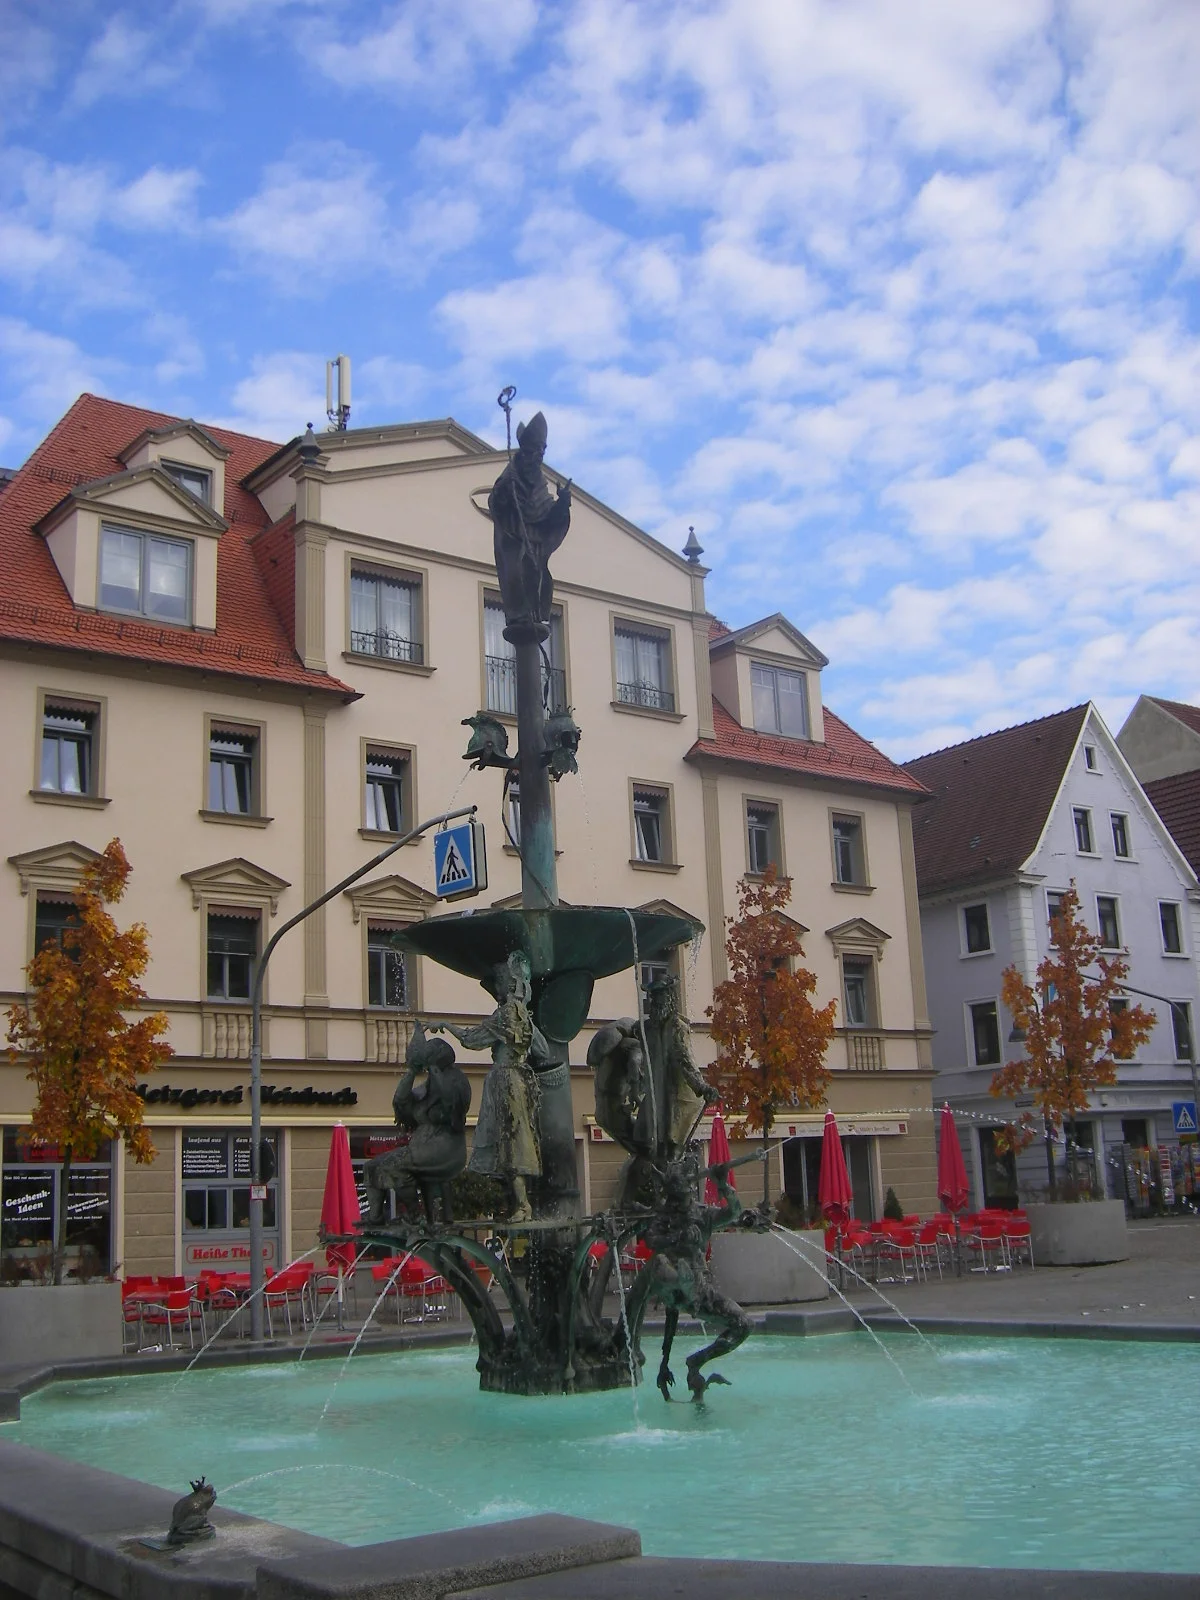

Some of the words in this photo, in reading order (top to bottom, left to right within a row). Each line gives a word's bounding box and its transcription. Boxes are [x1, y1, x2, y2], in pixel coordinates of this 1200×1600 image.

[5, 1189, 51, 1207] Geschenk-
[18, 1202, 44, 1214] Ideen
[193, 1248, 228, 1260] Heiße
[231, 1246, 268, 1259] Thee
